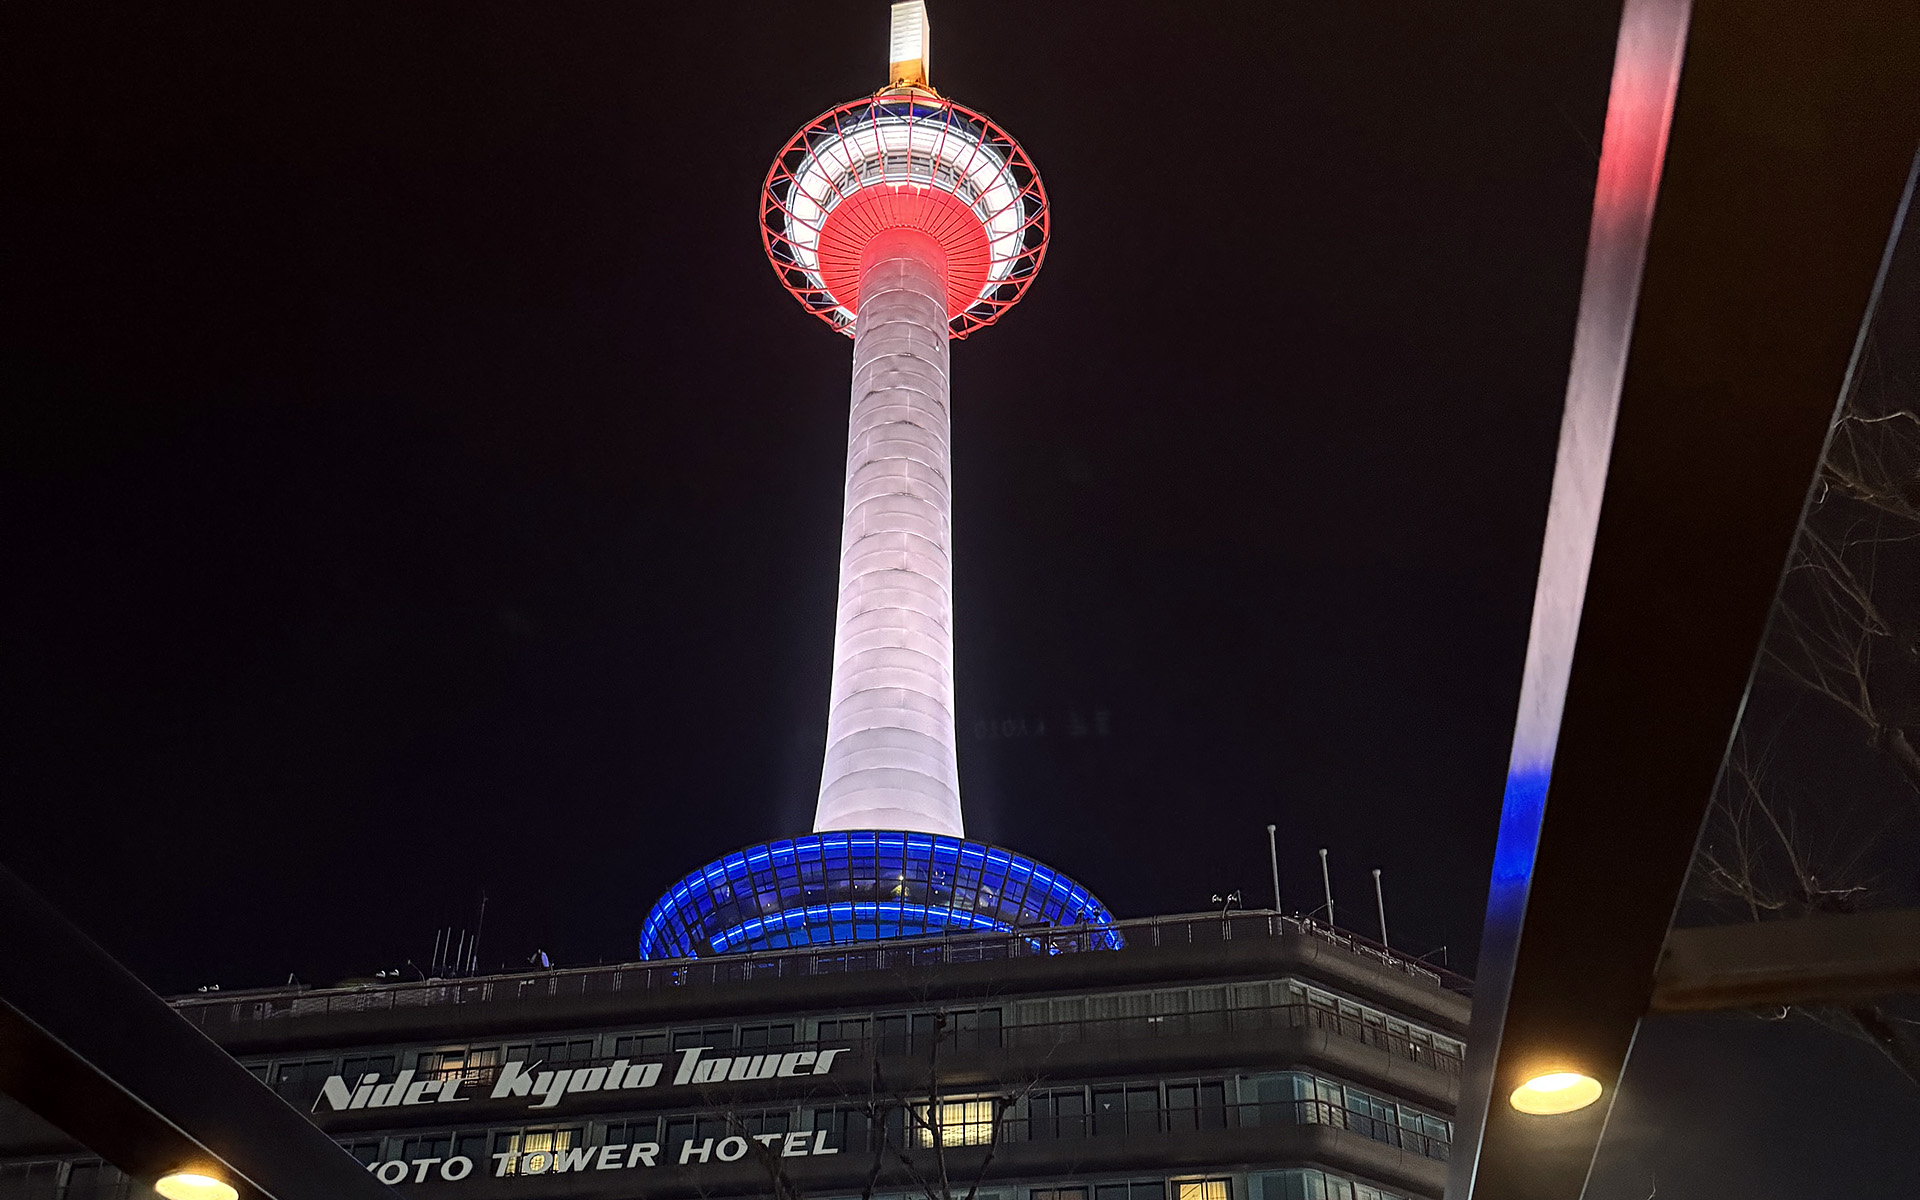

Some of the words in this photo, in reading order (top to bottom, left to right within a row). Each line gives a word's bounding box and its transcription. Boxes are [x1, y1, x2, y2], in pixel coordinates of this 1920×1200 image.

[311, 1069, 481, 1113] Nidec
[490, 1059, 664, 1109] Kyoto
[672, 1046, 851, 1086] Tower
[492, 1141, 660, 1178] TOWER
[679, 1129, 839, 1165] HOTEL
